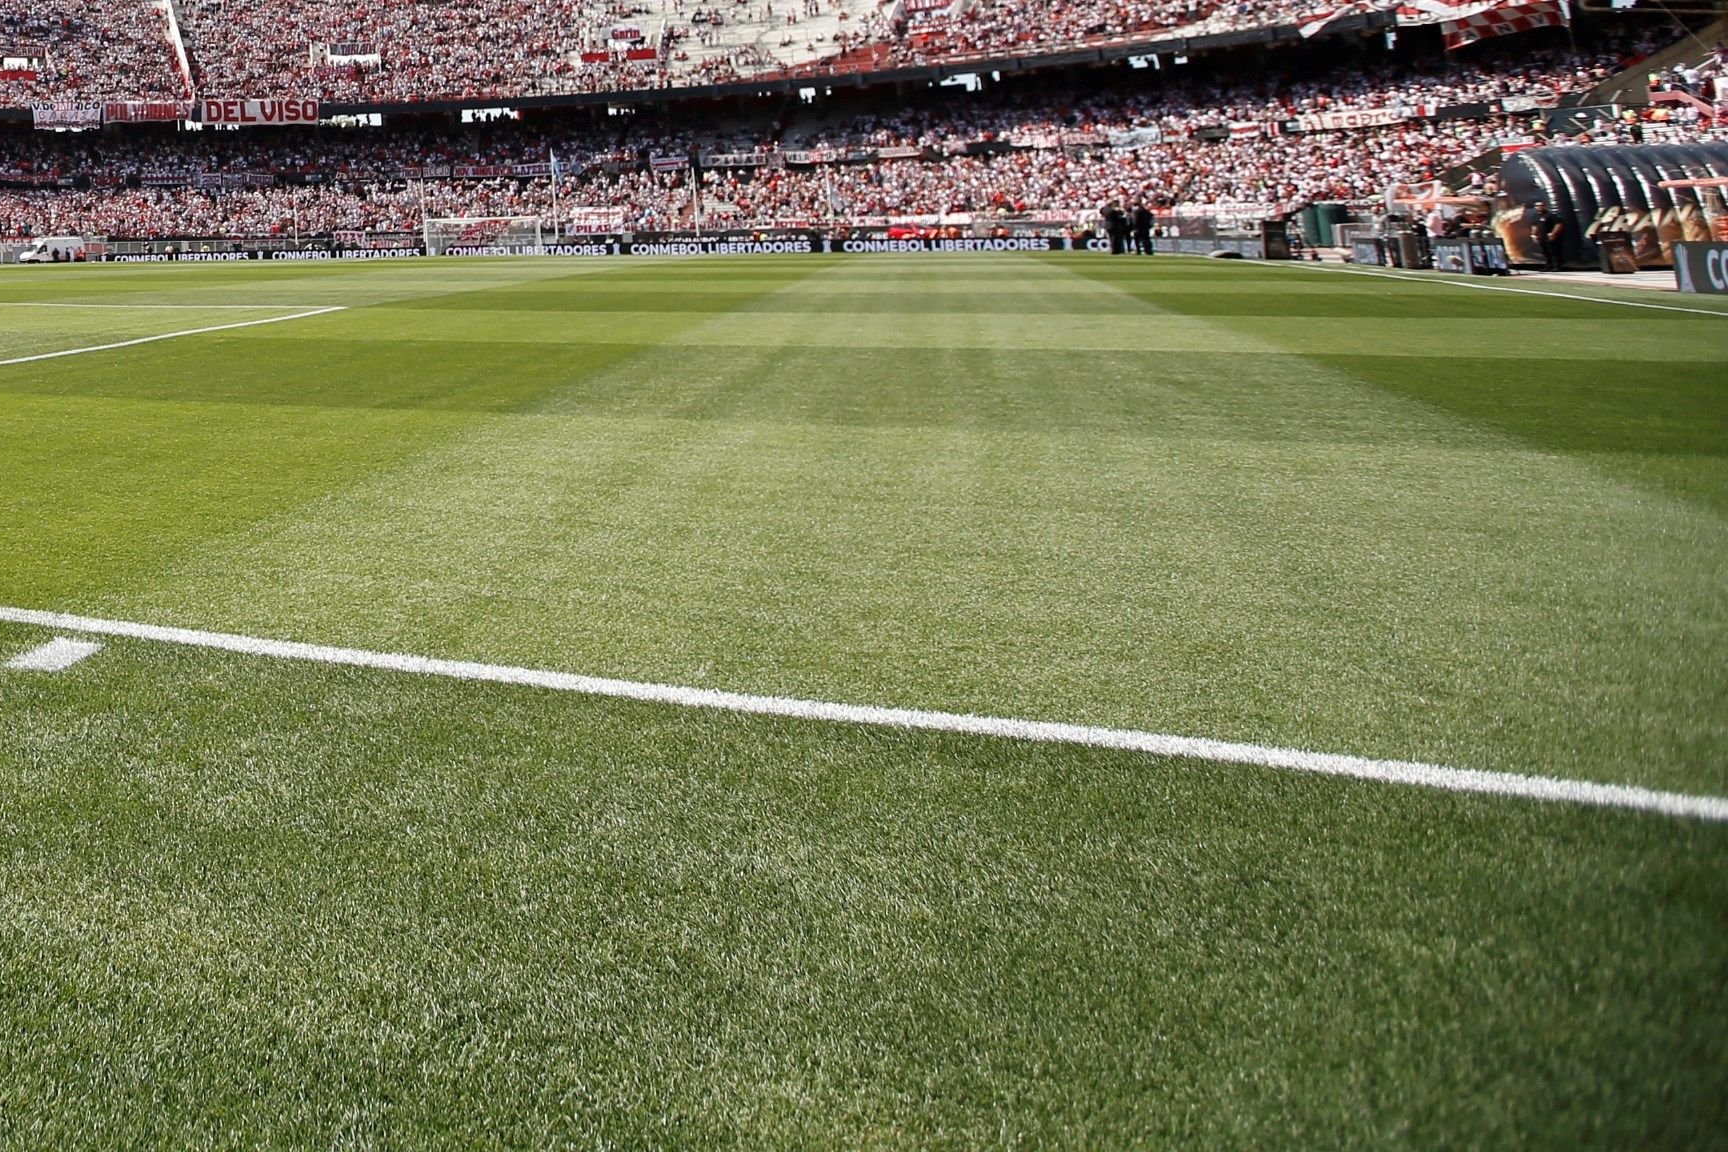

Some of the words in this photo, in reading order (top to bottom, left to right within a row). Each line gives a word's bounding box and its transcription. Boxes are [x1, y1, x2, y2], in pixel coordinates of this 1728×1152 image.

[206, 101, 257, 122] DEL
[260, 100, 318, 122] VISO
[515, 244, 607, 256] LIBERTADORES
[631, 242, 706, 255] CONMEBOL
[708, 241, 812, 254] LIBERTADORES
[843, 240, 927, 253] CONMEBOL
[931, 238, 1050, 252] LIBERTADORES
[173, 251, 249, 262] LIBERTADORES
[336, 248, 421, 259] LIBERTADORES
